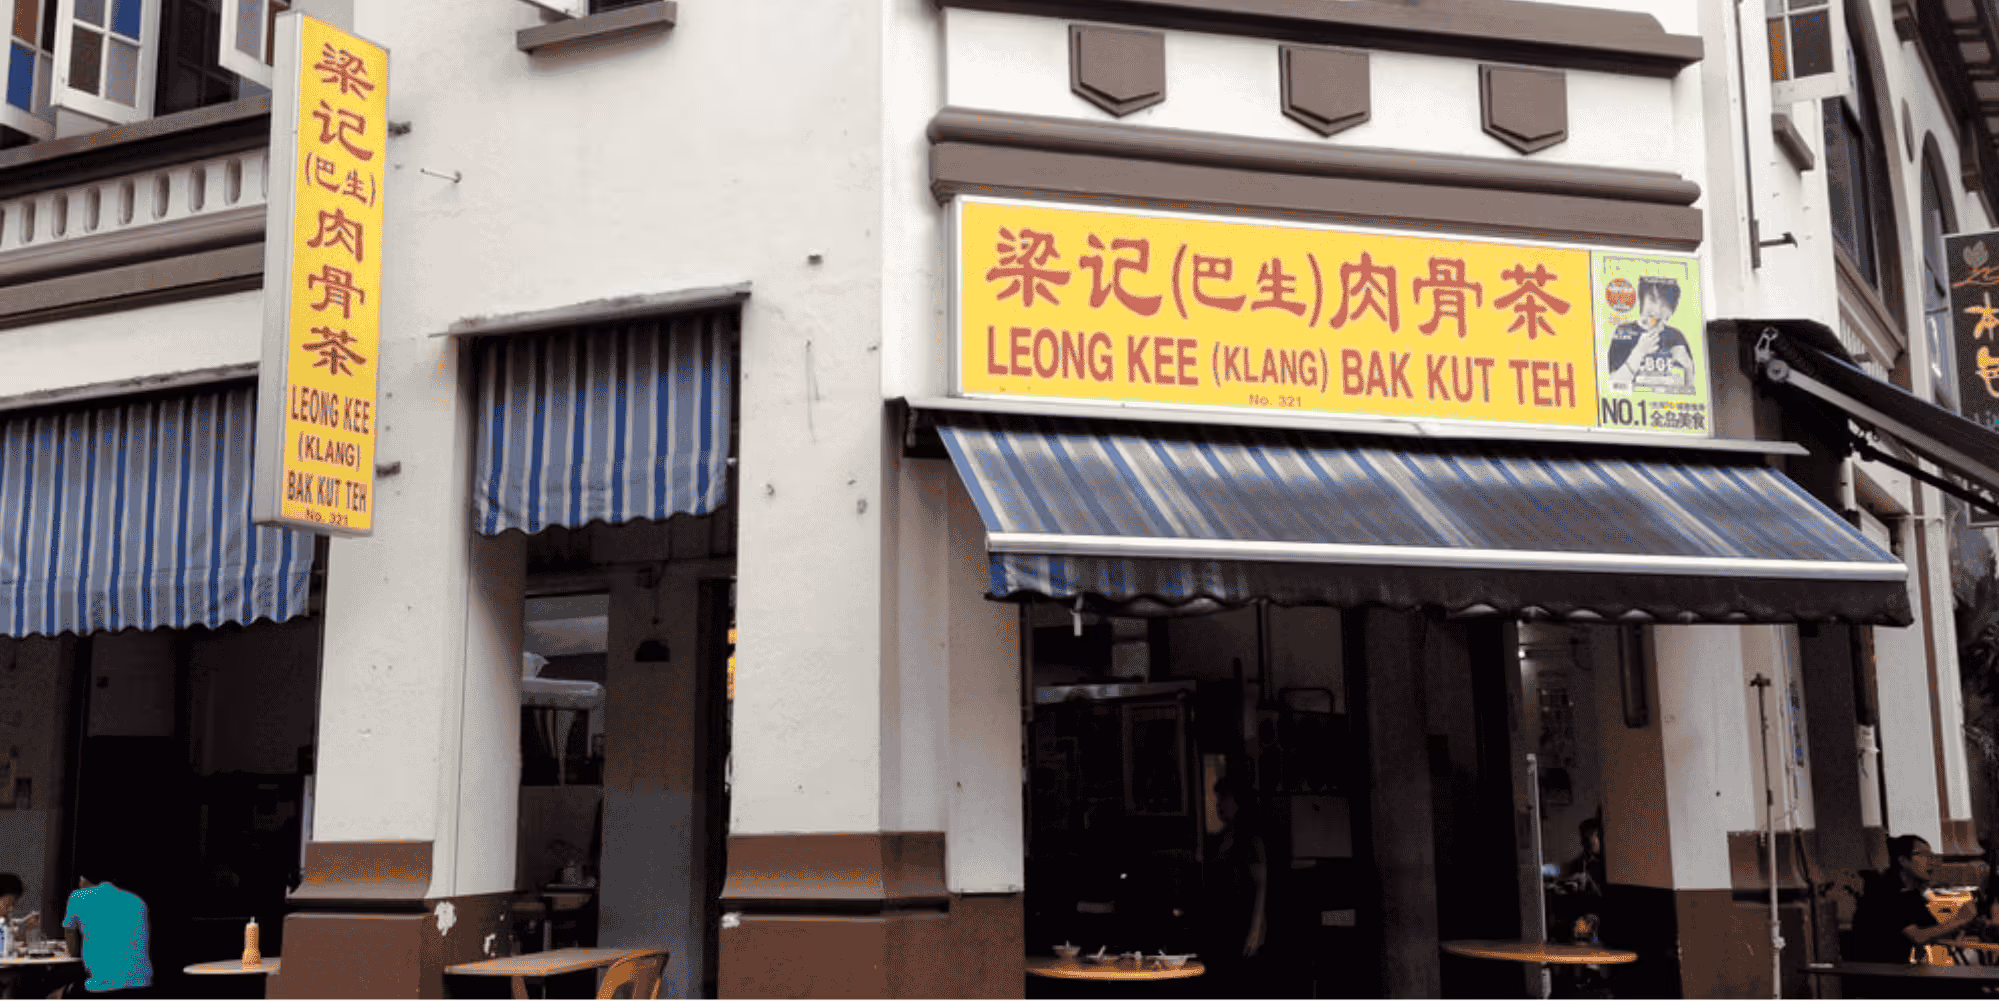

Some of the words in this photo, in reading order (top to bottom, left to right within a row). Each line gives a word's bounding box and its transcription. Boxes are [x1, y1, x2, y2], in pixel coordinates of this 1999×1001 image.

[302, 41, 376, 376] 梁记(巴生)肉骨茶
[985, 226, 1572, 341] 梁记(巴生)肉骨茶
[987, 325, 1114, 383] LEONG
[1127, 335, 1199, 386] KEE
[1212, 341, 1328, 393] (KLANG)
[1341, 348, 1414, 399] BAK
[1426, 354, 1495, 403] KUT
[1508, 359, 1576, 408] TEH
[291, 384, 339, 428] LEONG
[343, 395, 370, 435] KEE
[1249, 393, 1273, 406] No.
[1278, 394, 1301, 407] 321
[1601, 397, 1647, 427] NO.1
[297, 430, 361, 473] (KLANG)
[287, 469, 314, 504] BAK
[317, 475, 342, 508] KUT
[346, 480, 368, 513] TEH
[329, 511, 348, 527] 321
